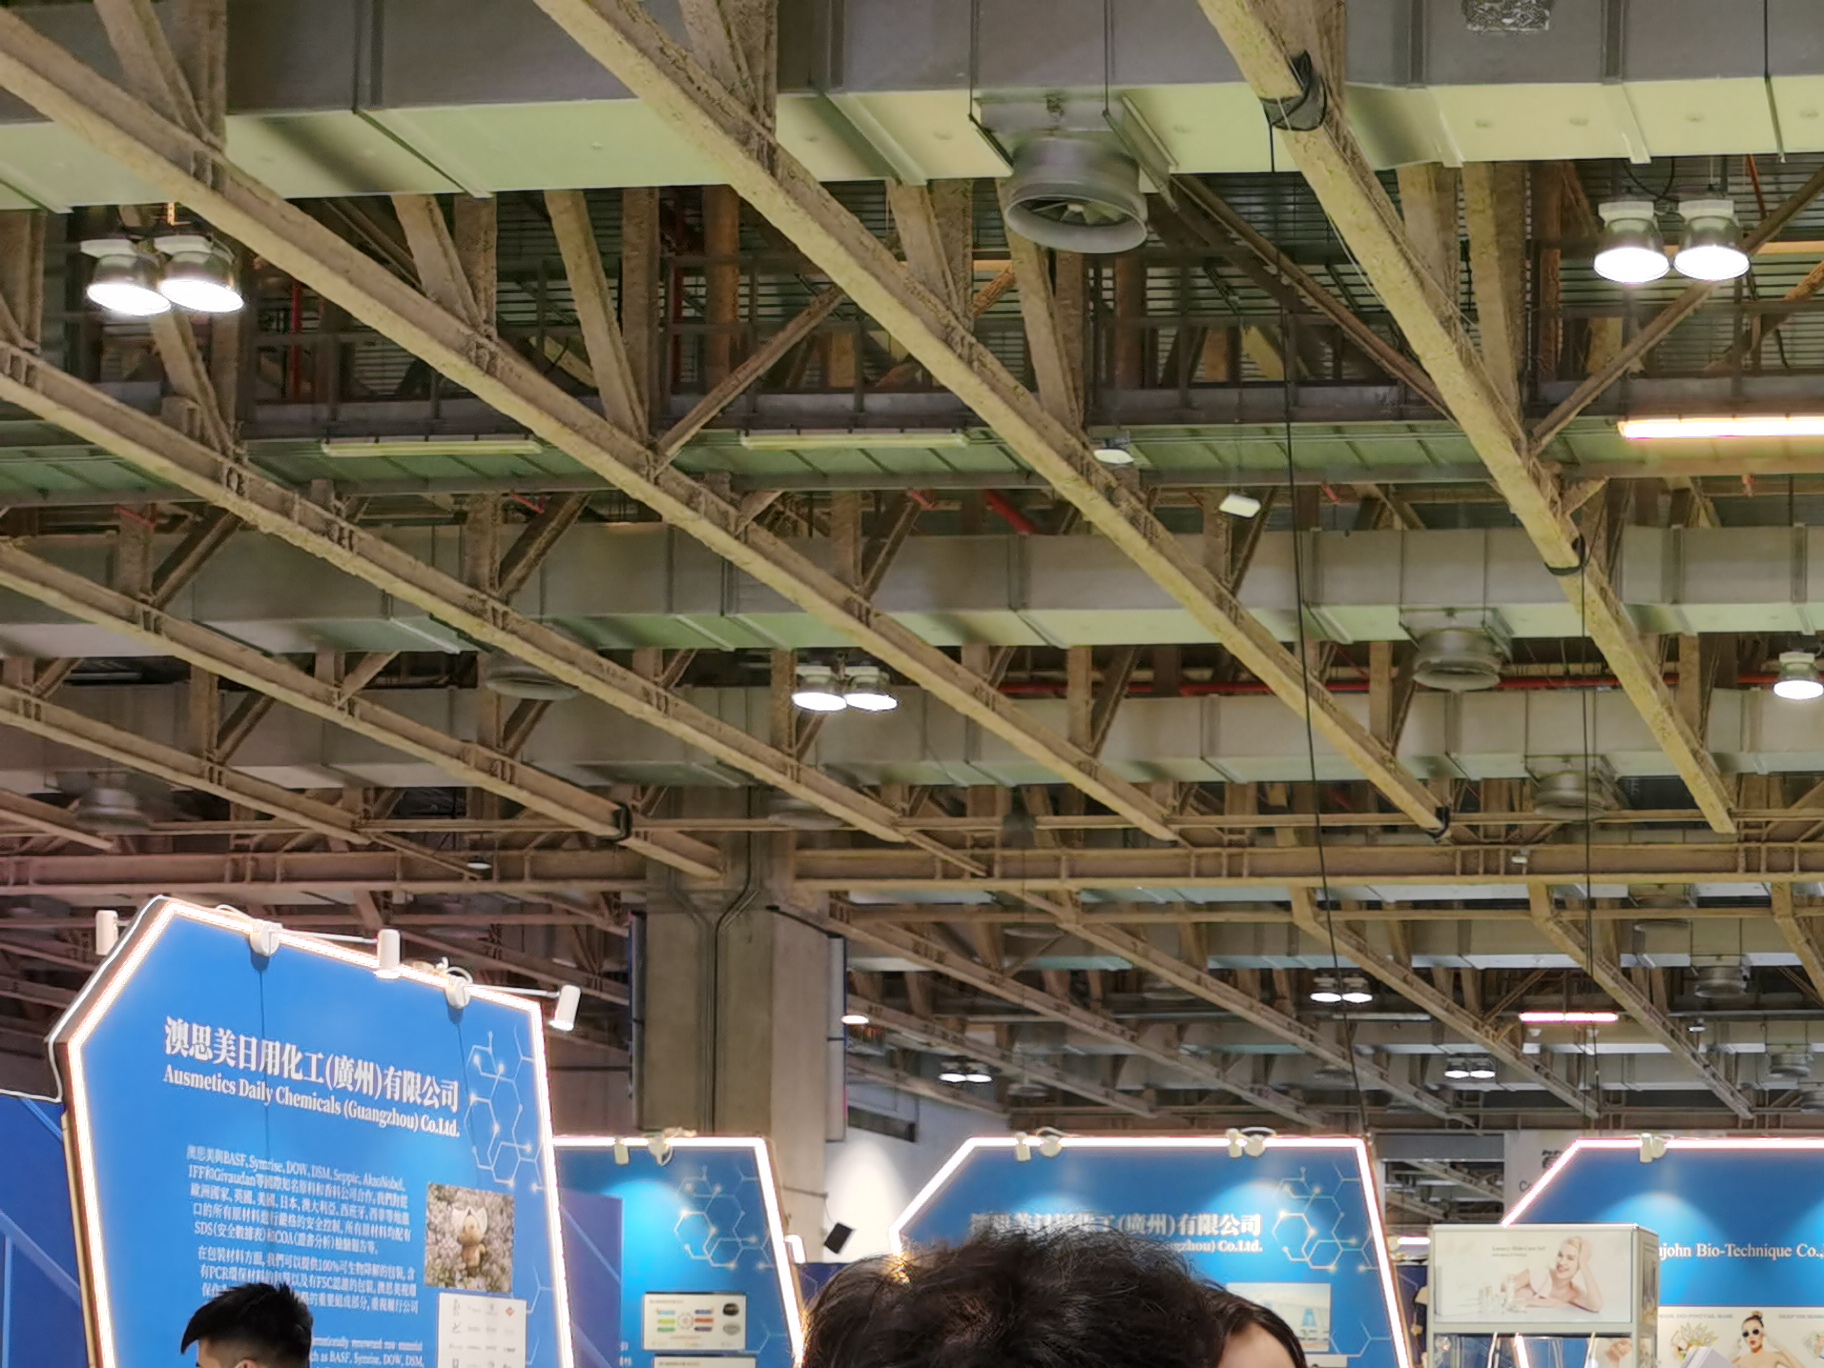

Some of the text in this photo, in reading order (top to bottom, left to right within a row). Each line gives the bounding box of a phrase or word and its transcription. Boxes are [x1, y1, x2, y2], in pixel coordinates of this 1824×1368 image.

[163, 1064, 461, 1138] Ausmetics Daily Chemicals (Guangzhou) Co.Ltd.
[1218, 1240, 1264, 1253] Co.Ltd.
[1697, 1243, 1793, 1260] Bio-Technique
